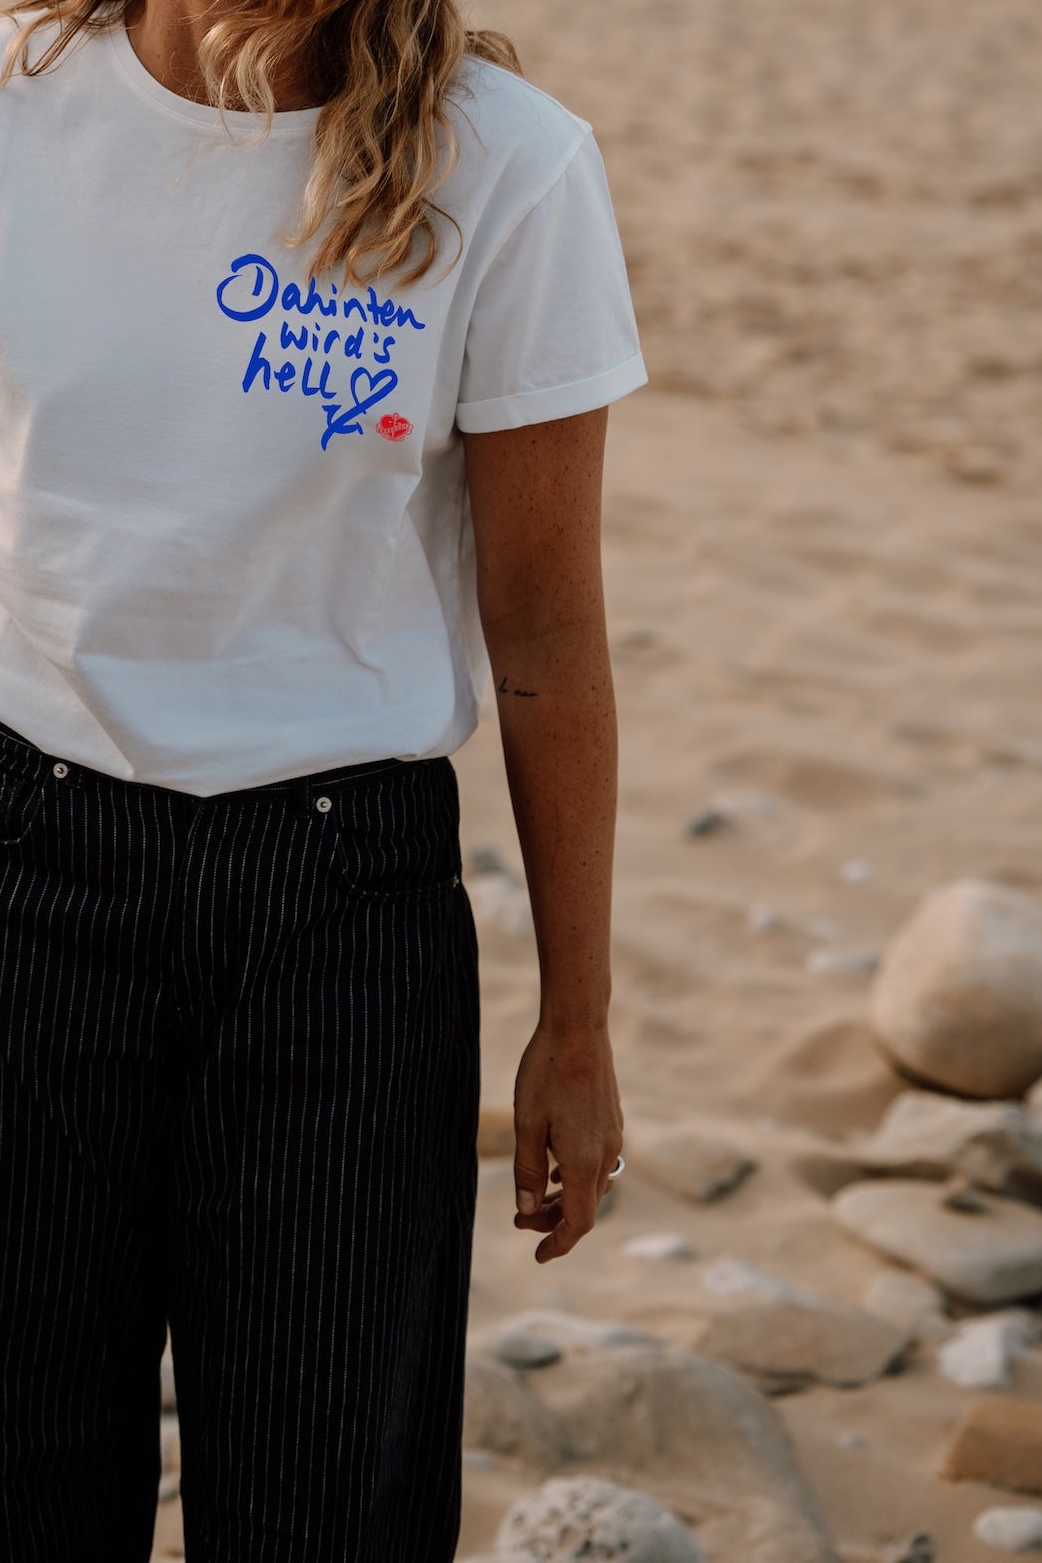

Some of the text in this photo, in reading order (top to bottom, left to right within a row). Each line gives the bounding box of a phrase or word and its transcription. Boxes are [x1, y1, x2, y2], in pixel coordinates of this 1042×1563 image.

[215, 252, 427, 331] Dahinten
[241, 330, 338, 401] hell
[279, 320, 397, 365] wird's
